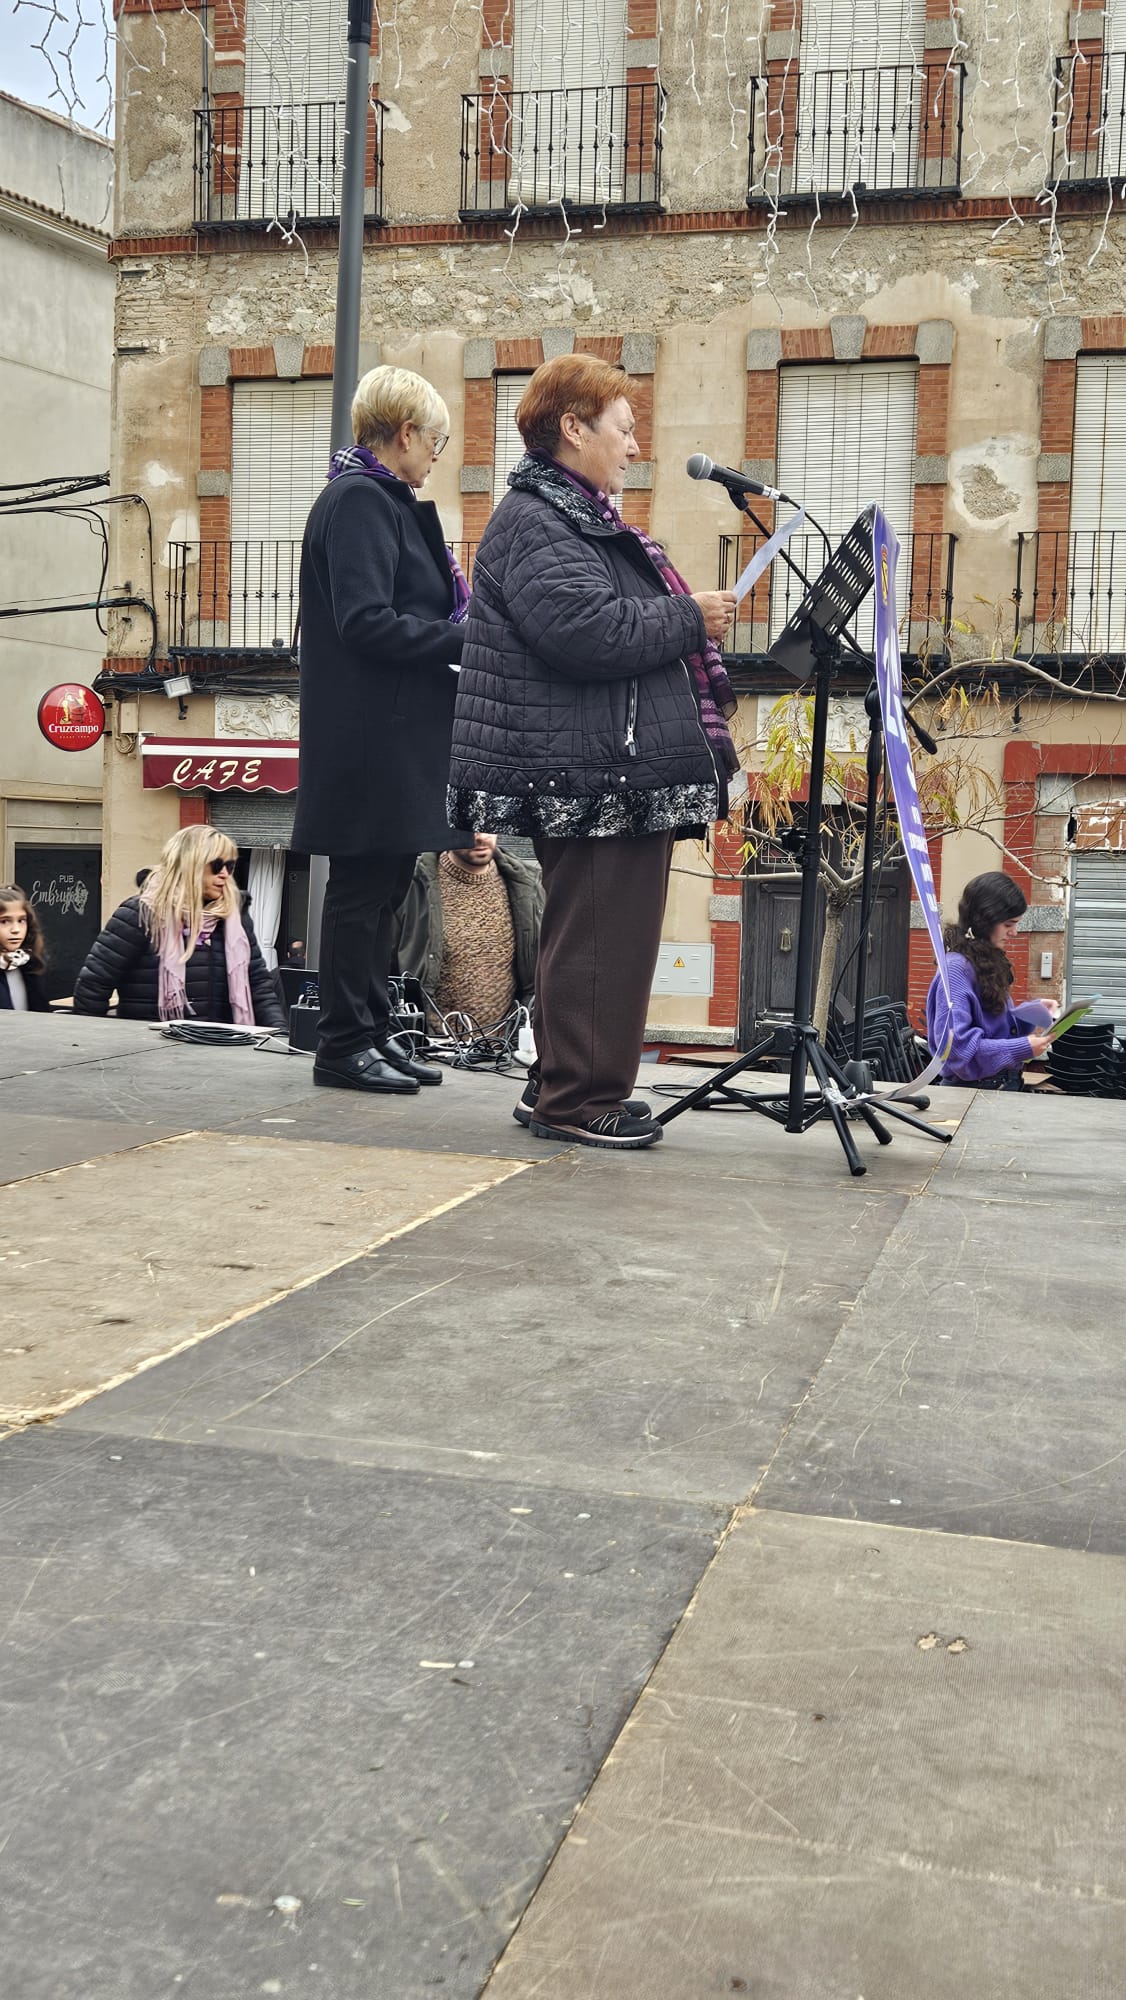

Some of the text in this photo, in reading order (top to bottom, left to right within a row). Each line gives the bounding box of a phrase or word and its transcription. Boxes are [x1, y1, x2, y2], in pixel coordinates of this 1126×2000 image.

[48, 724, 99, 734] Cruzcampo
[172, 758, 262, 784] CAFE
[59, 874, 74, 883] PUB
